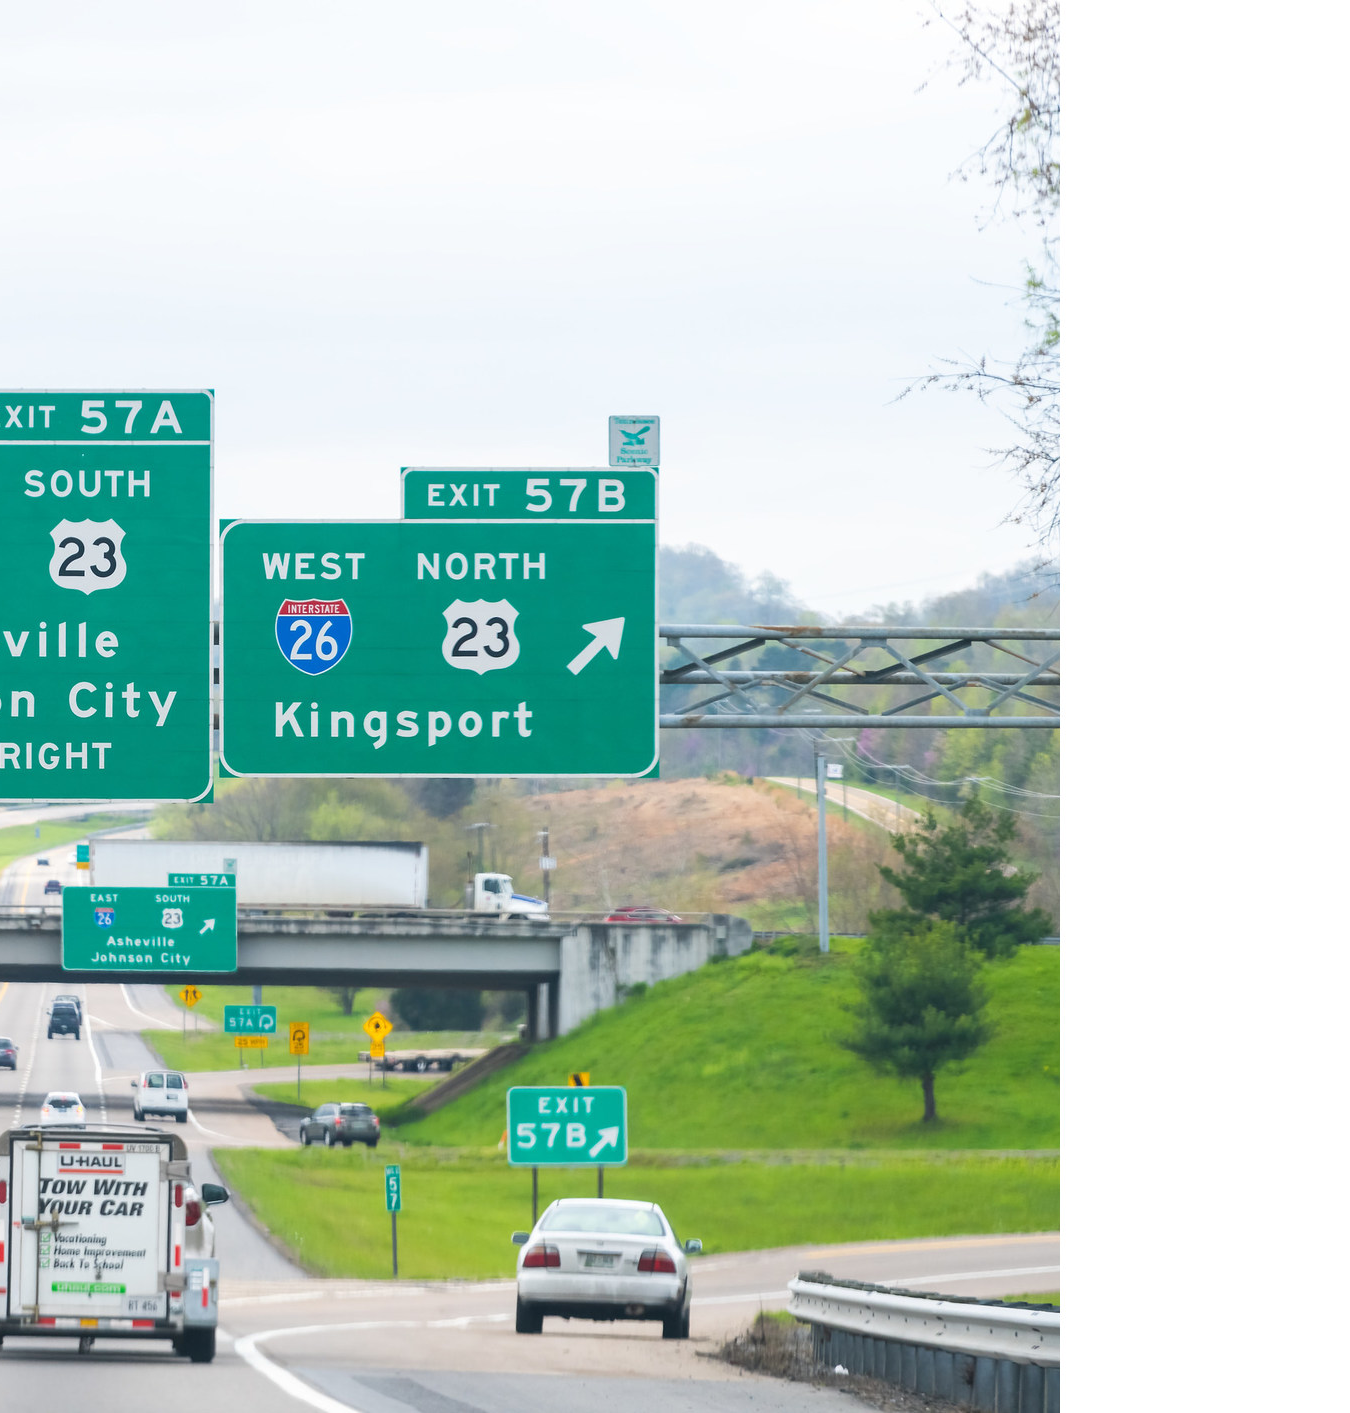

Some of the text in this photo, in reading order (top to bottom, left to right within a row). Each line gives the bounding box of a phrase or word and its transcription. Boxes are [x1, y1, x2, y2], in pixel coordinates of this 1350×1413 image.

[81, 400, 183, 434] 57A
[24, 469, 151, 498] SOUTH
[427, 478, 626, 513] EXIT 57B
[58, 536, 117, 578] 23
[262, 552, 365, 580] WEST
[417, 552, 546, 580] NORTH
[287, 604, 340, 614] INTERSTATE
[290, 619, 338, 661] 26
[451, 616, 510, 658] 23
[68, 681, 177, 727] City
[275, 701, 533, 750] Kingsport
[0, 741, 112, 770] RIGHT
[174, 875, 229, 886] EXIT 57A
[90, 893, 118, 902] EAST
[155, 894, 190, 903] SOUTH
[98, 912, 112, 925] 26
[164, 912, 181, 925] 23
[106, 936, 175, 947] Asheville
[91, 952, 191, 966] Johnson City
[230, 1018, 253, 1027] 57A
[538, 1096, 595, 1114] EXIT
[516, 1122, 587, 1149] 57B
[60, 1155, 122, 1168] U-HAUL
[94, 1179, 148, 1196] WITH
[100, 1199, 144, 1216] CAR
[54, 1232, 107, 1246] Vacationing
[54, 1245, 146, 1258] Home Improvement
[53, 1258, 124, 1270] Back To School
